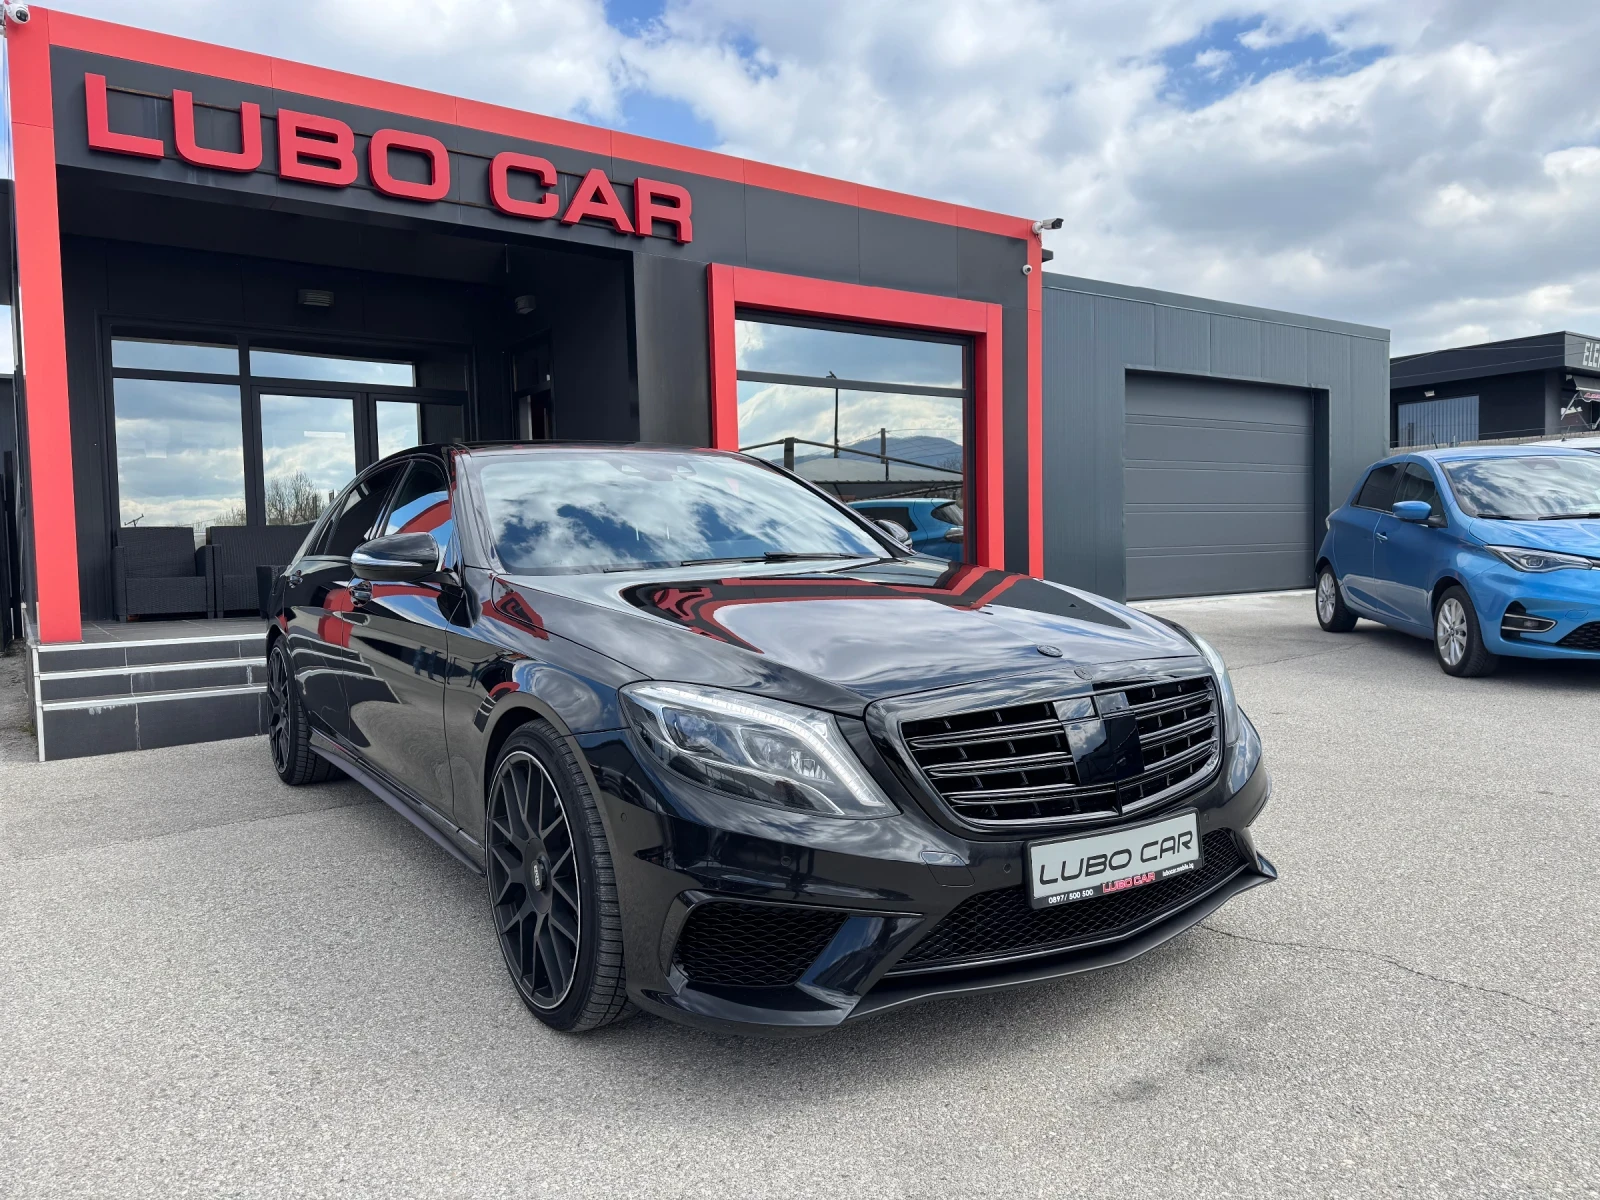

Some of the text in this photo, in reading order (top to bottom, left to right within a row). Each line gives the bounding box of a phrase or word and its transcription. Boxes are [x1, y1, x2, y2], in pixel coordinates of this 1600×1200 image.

[84, 72, 693, 244] LUBO CAR
[1582, 341, 1600, 369] ELE
[1039, 830, 1193, 885] LUBO CAR
[1048, 888, 1094, 904] 0897/ 500 500
[1102, 871, 1156, 894] LUBO CAR
